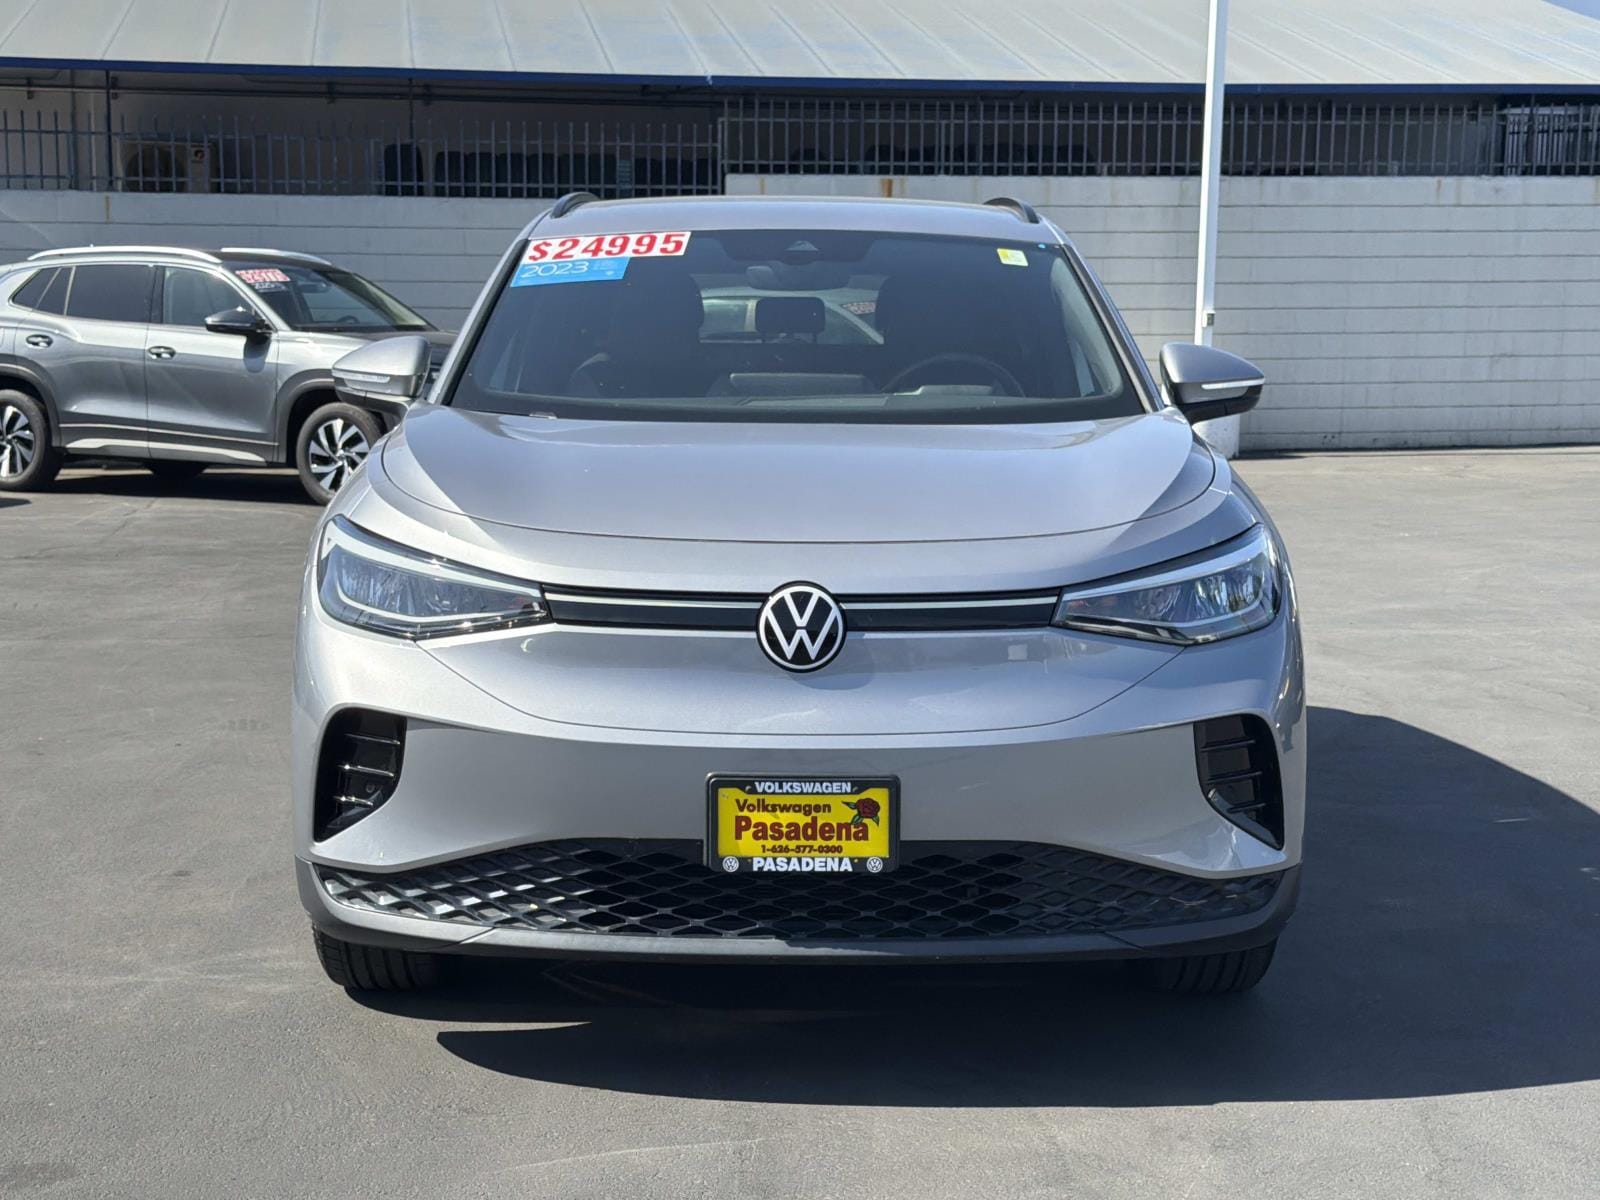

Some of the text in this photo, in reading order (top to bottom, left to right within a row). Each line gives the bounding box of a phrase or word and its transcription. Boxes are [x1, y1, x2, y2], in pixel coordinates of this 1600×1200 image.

[528, 233, 686, 262] $24995
[521, 261, 588, 277] 2023
[759, 585, 843, 669] VW
[754, 782, 851, 793] VOLKSWAGEN
[735, 799, 832, 816] Volkswagen
[734, 815, 869, 841] Pasadena
[761, 844, 843, 854] 1-626-577-0300
[752, 857, 853, 872] PASADENA
